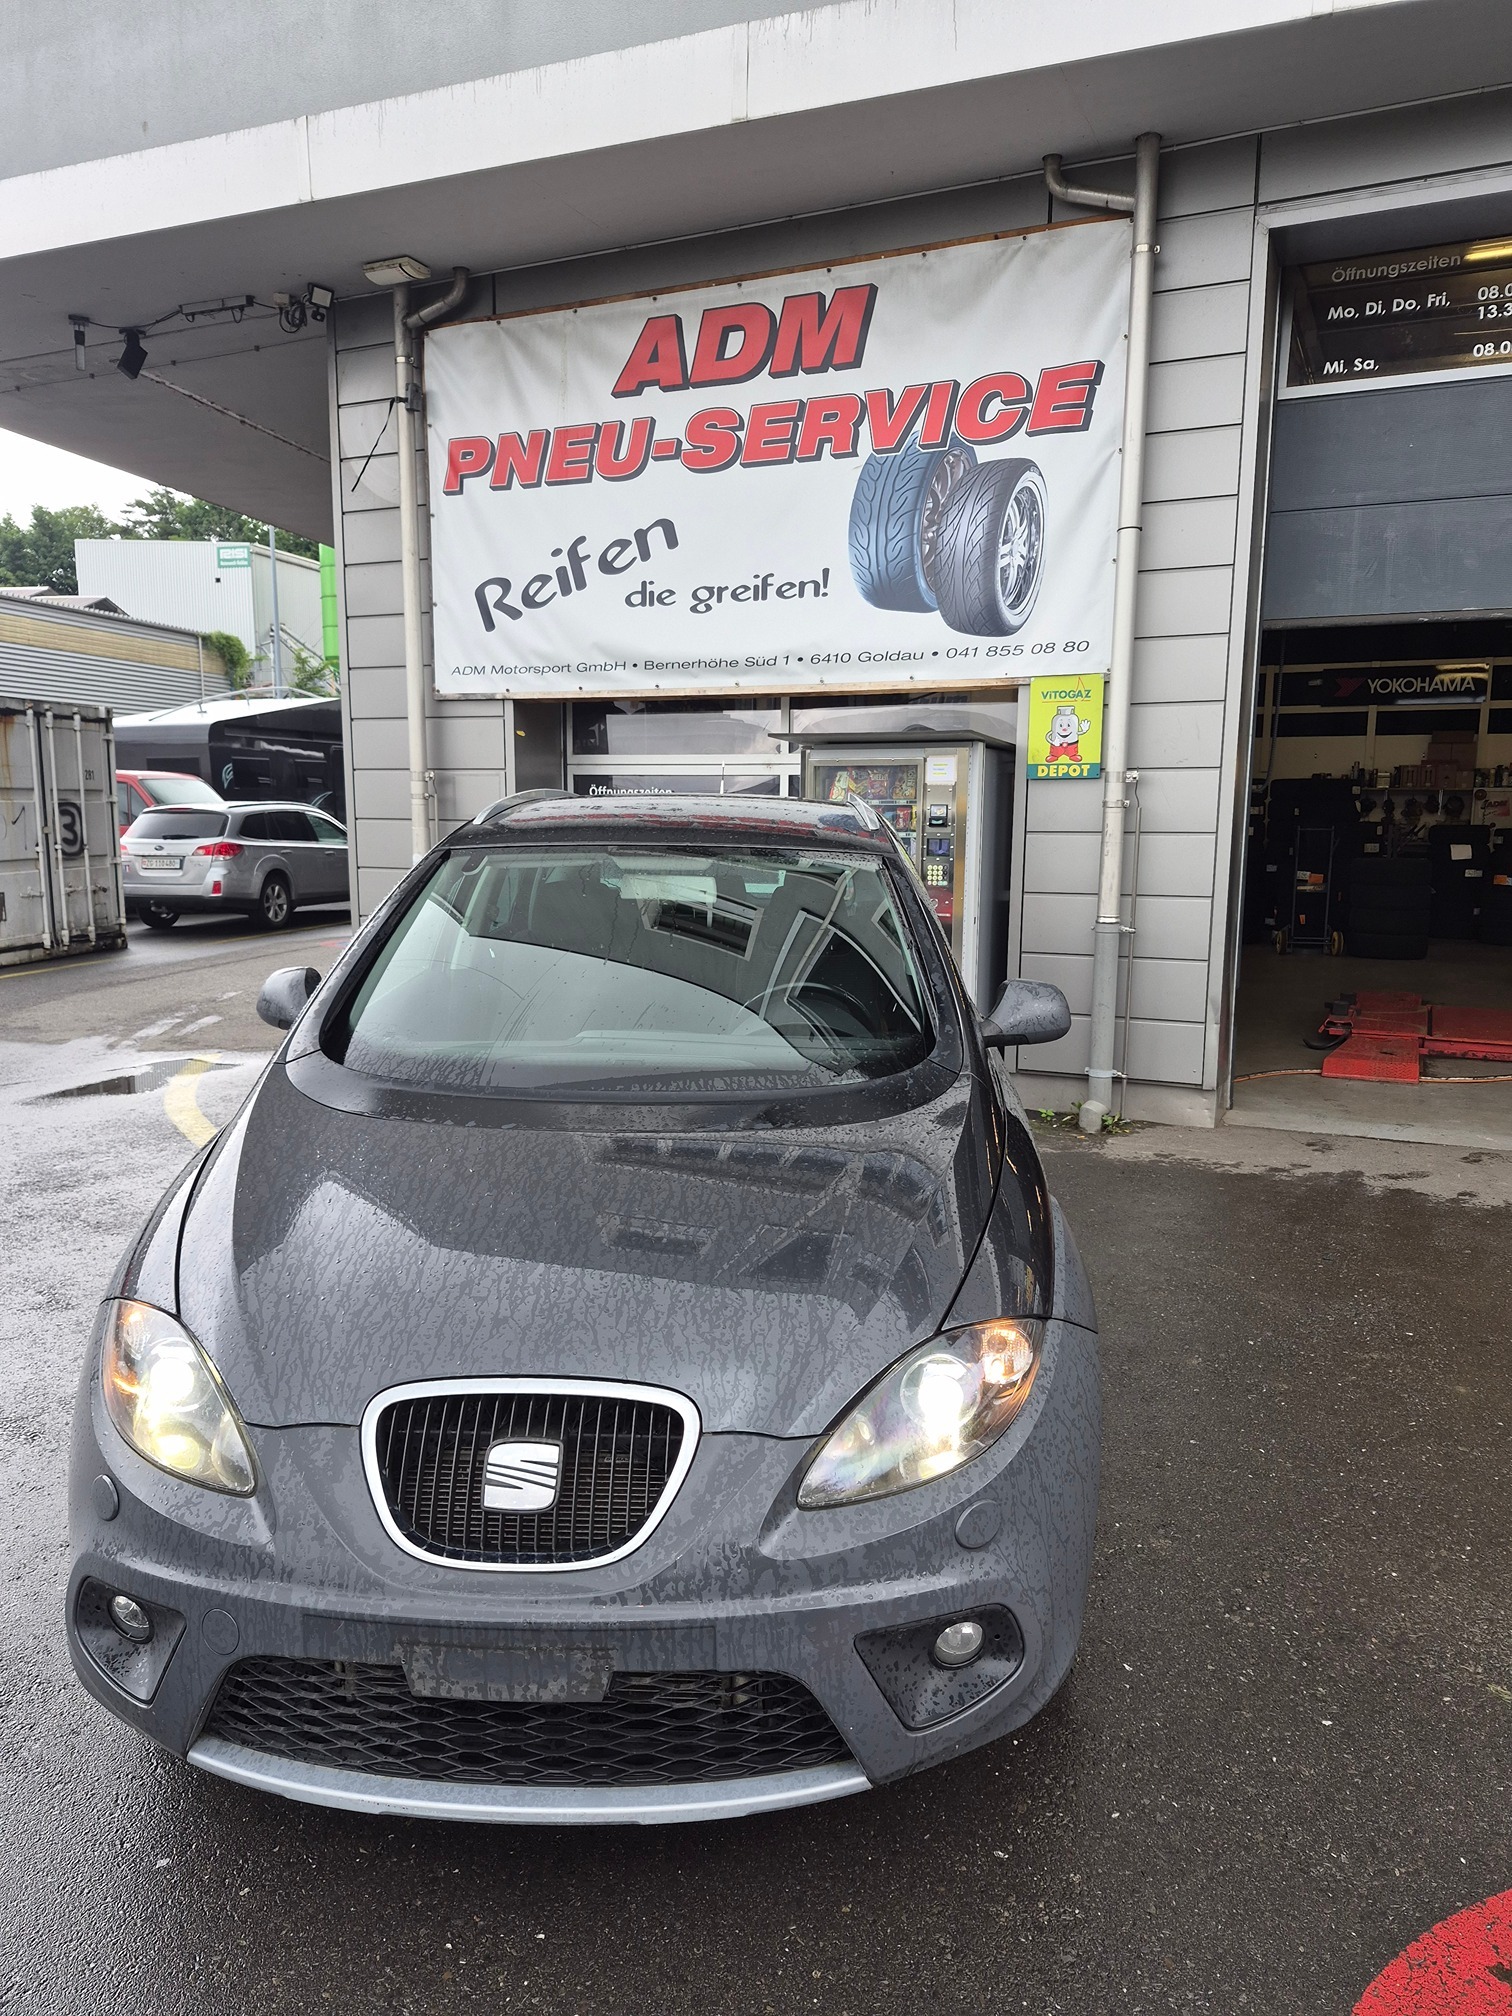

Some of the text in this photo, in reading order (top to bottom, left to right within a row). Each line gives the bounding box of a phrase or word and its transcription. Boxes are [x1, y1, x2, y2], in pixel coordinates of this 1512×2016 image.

[1331, 255, 1461, 283] Öffnungszeiten
[1327, 306, 1360, 321] Mo,
[1365, 301, 1387, 316] Di,
[1392, 298, 1422, 313] Do,
[1427, 292, 1451, 308] Fri,
[612, 283, 878, 398] ADM
[1323, 360, 1348, 375] Mi,
[1353, 357, 1380, 372] Sa,
[443, 360, 1105, 496] PNEU-SERVICE
[474, 518, 680, 633] Reifen
[625, 567, 830, 614] die greifen!
[451, 640, 1091, 677] ADM Motorsport GmbH Bernerhöhe Süd 1 6410 Goldau 041 855 08 80
[1367, 676, 1476, 694] YOKOHAMA
[1037, 764, 1091, 777] DEPOT
